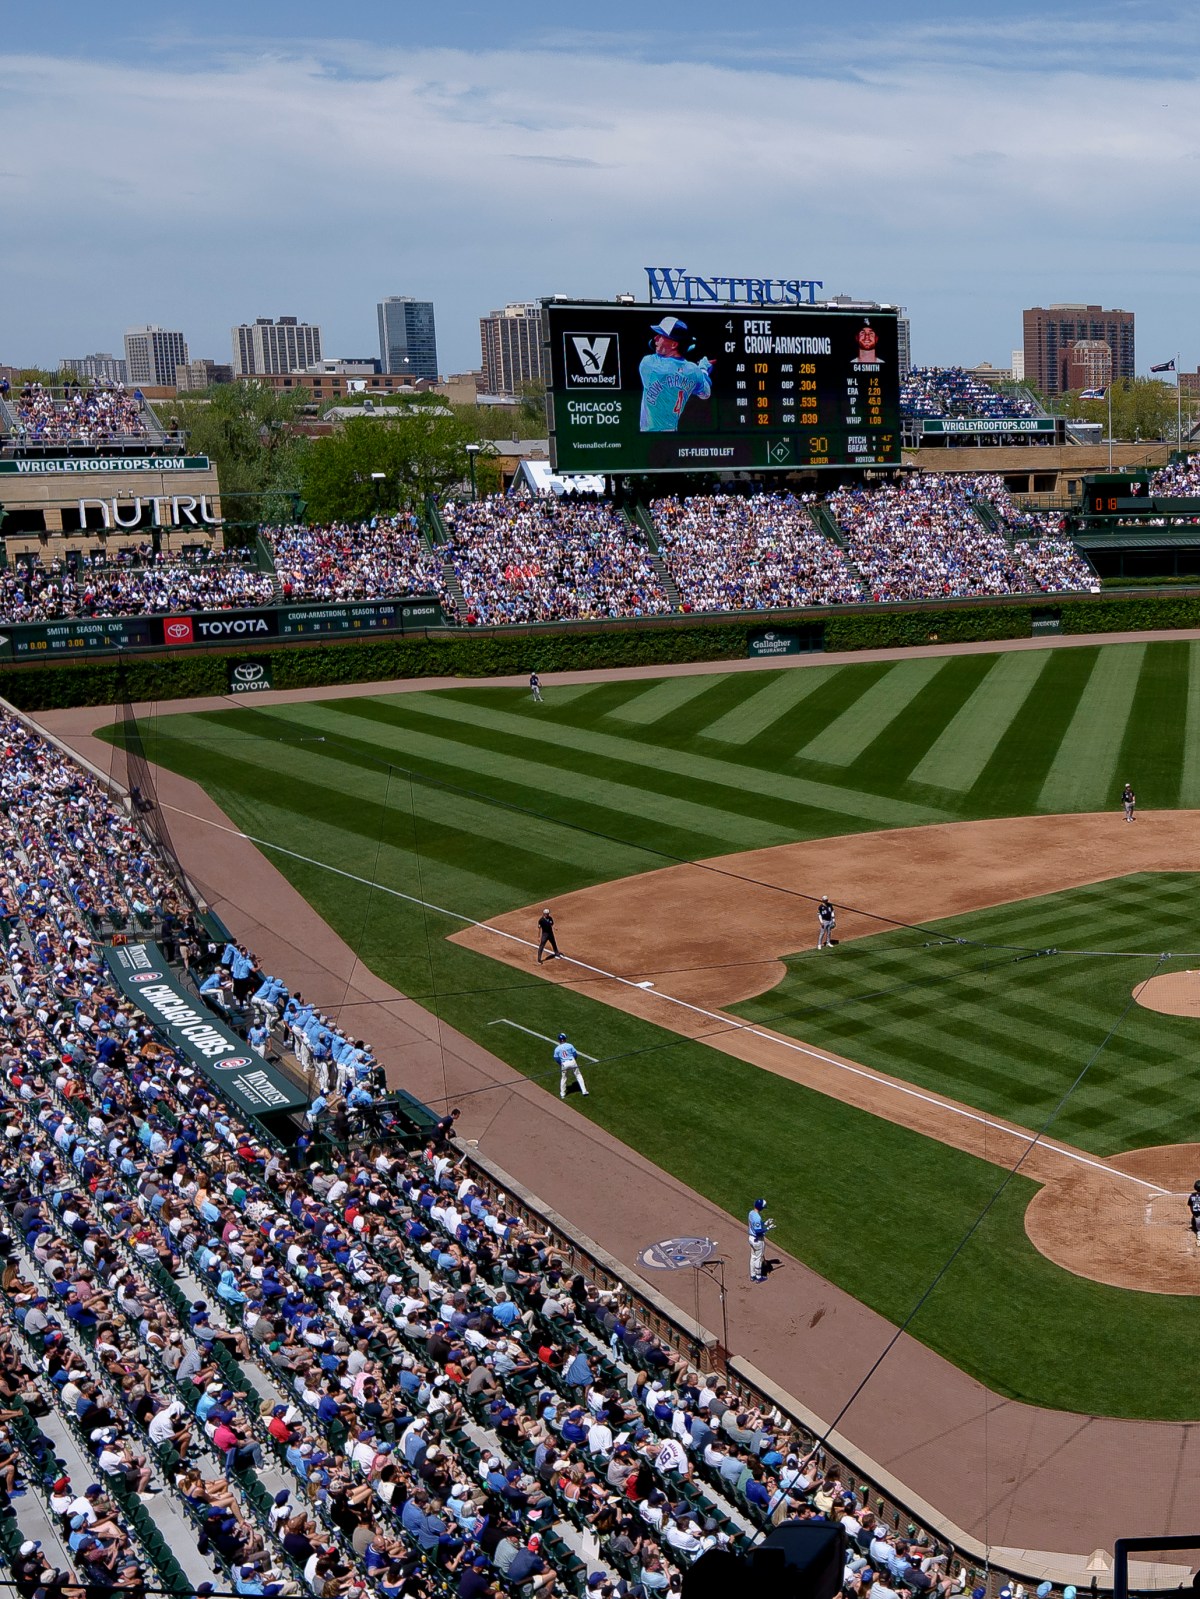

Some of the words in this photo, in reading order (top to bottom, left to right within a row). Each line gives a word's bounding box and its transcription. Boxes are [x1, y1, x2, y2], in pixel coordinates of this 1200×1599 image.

[644, 267, 823, 305] WINTRUST
[725, 320, 733, 333] 4
[743, 320, 772, 334] PETE
[724, 341, 736, 353] CF
[744, 336, 831, 354] CROW-ARMSTRONG
[736, 363, 746, 372] AB
[754, 363, 768, 374] 170
[781, 364, 793, 373] AVG
[799, 363, 816, 374] .265
[571, 374, 598, 384] Vienna
[598, 374, 616, 386] Beef
[736, 381, 746, 389] HR
[781, 381, 794, 389] OBP
[799, 381, 817, 391] .304
[567, 401, 622, 412] CHICAGO'S
[673, 390, 684, 414] 4
[736, 398, 748, 406] RBI
[757, 397, 768, 407] 30
[782, 398, 794, 406] SLG
[800, 397, 817, 407] .535
[571, 414, 593, 425] HOT
[596, 413, 620, 424] DOG
[758, 414, 768, 424] 32
[782, 414, 795, 423] OPS
[941, 420, 1038, 431] WRIGLEYROOFTOPS.COM
[809, 437, 828, 452] 90
[848, 436, 867, 444] PITCH
[710, 448, 718, 456] TO
[719, 448, 734, 456] LEFT
[847, 444, 868, 452] BREAK
[16, 458, 185, 472] WRIGLEYROOFTOPS.COM
[288, 609, 346, 620] CROW-ARMSTRONG
[351, 608, 375, 616] SEASON
[379, 606, 394, 614] CUBS
[412, 607, 435, 615] BOSCH
[47, 627, 69, 636] SMITH
[76, 625, 103, 634] SEASON
[108, 623, 123, 632] CWS
[198, 618, 268, 636] TOYOTA
[753, 639, 791, 649] Gallagher
[231, 679, 270, 691] TOYOTA
[139, 984, 203, 1026] CHICAGO
[181, 1025, 235, 1056] CUBS
[244, 1069, 290, 1105] WINTRUST
